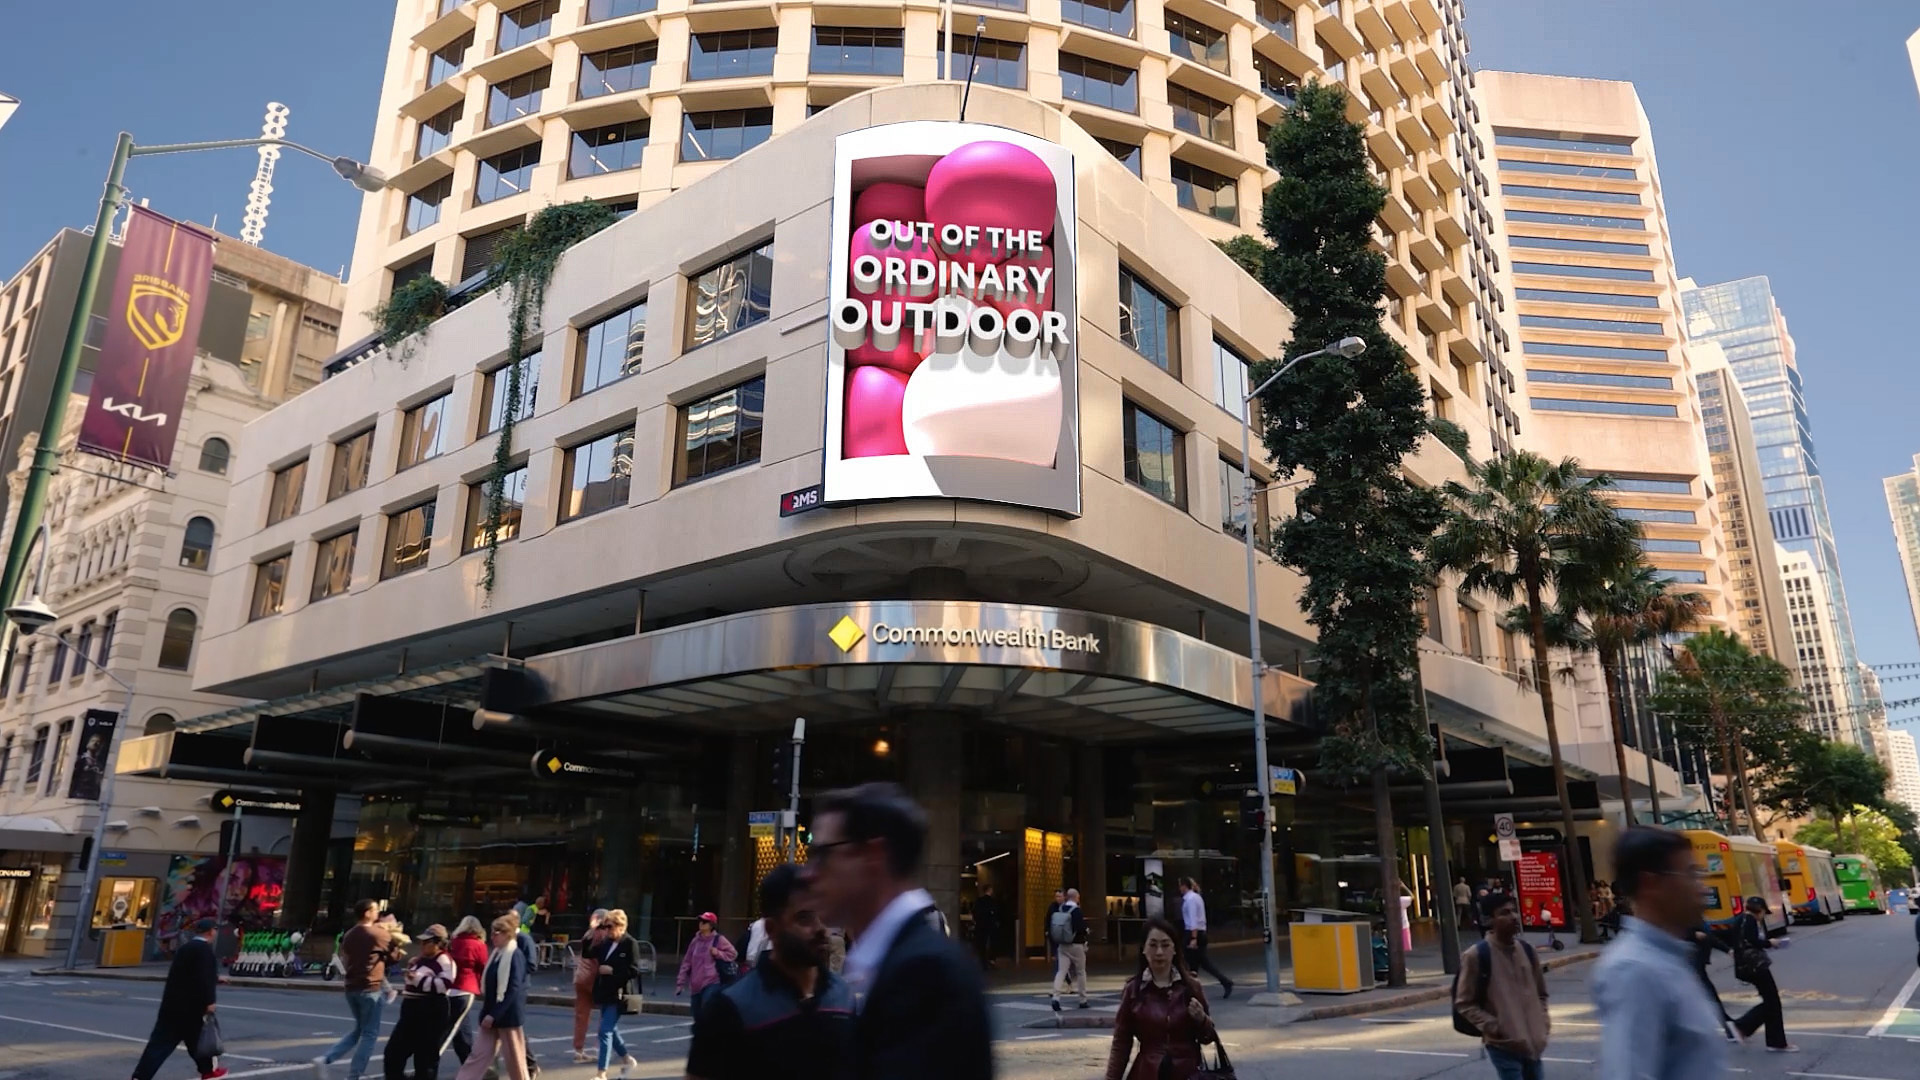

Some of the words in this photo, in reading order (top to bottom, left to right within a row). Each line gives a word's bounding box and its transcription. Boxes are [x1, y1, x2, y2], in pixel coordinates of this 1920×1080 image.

[869, 218, 935, 247] OUT
[940, 223, 981, 250] OF
[985, 226, 1044, 255] THE
[132, 273, 191, 303] BRISBANE
[853, 254, 1053, 298] ORDINARY
[833, 297, 1069, 352] OUTDOOR
[872, 622, 1048, 650] Commonwealth
[1051, 628, 1100, 654] Bank
[1499, 822, 1511, 832] 40
